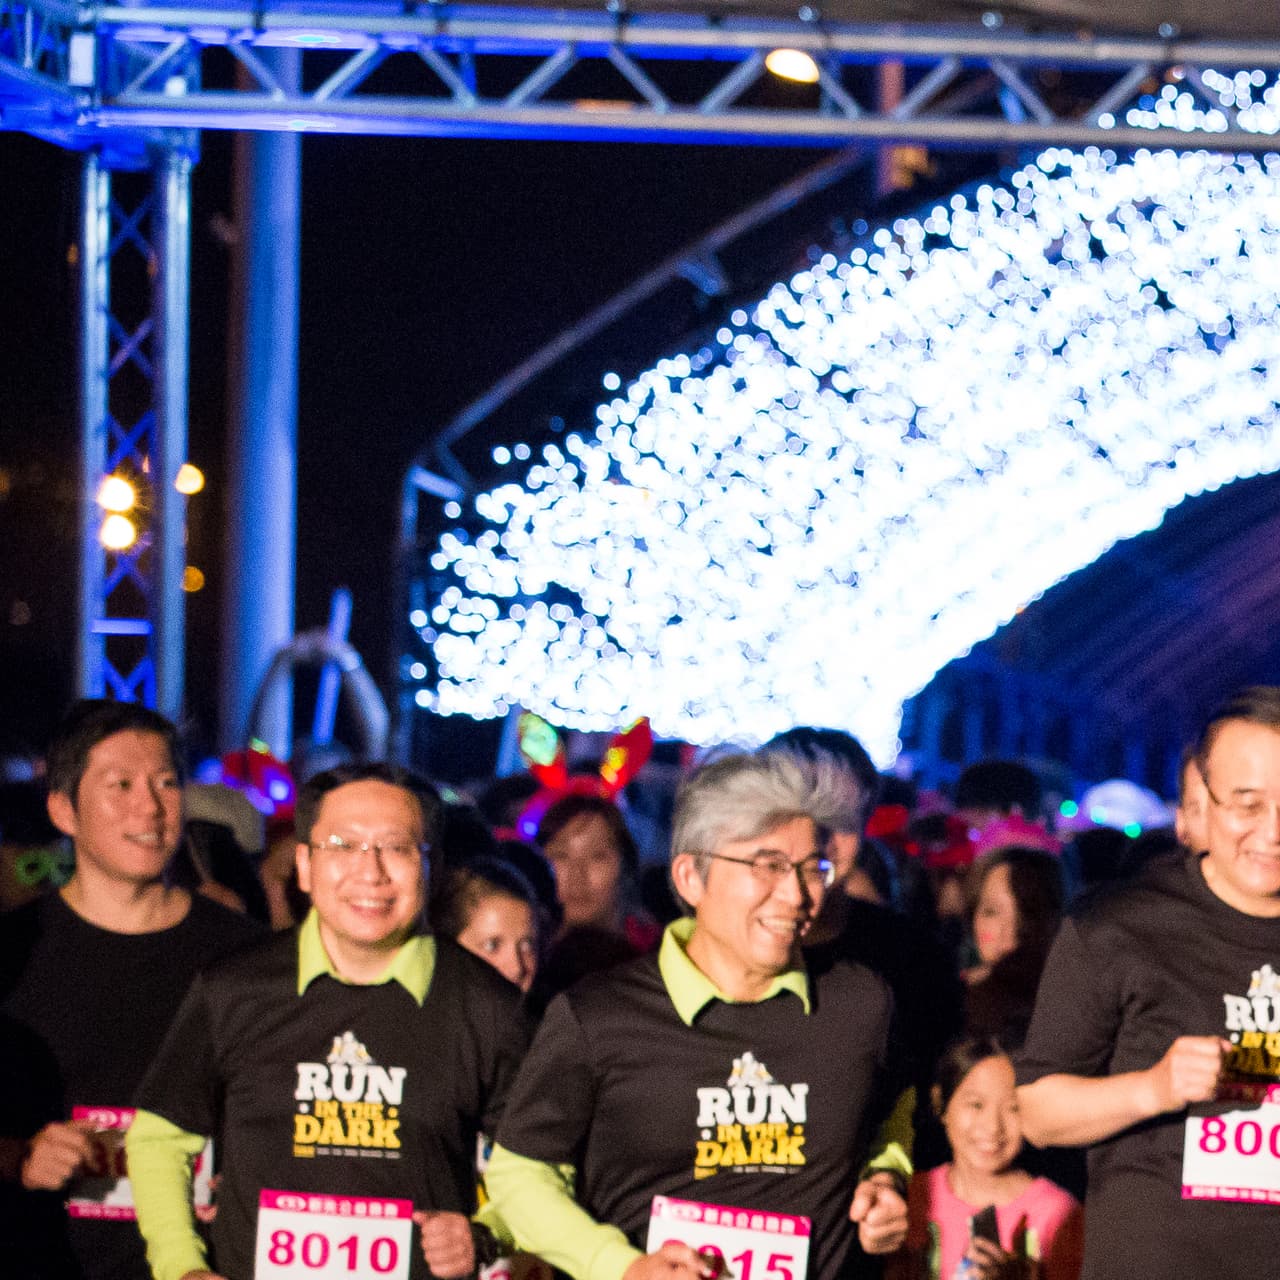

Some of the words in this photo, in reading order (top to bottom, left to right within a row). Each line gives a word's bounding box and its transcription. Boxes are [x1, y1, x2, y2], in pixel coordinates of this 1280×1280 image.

[294, 1062, 407, 1105] RUN
[314, 1100, 340, 1118] IN
[341, 1102, 384, 1120] THE
[697, 1083, 809, 1128] RUN
[293, 1114, 402, 1149] DARK
[717, 1123, 742, 1142] IN
[744, 1122, 789, 1140] THE
[695, 1135, 806, 1167] DARK
[268, 1229, 399, 1274] 8010
